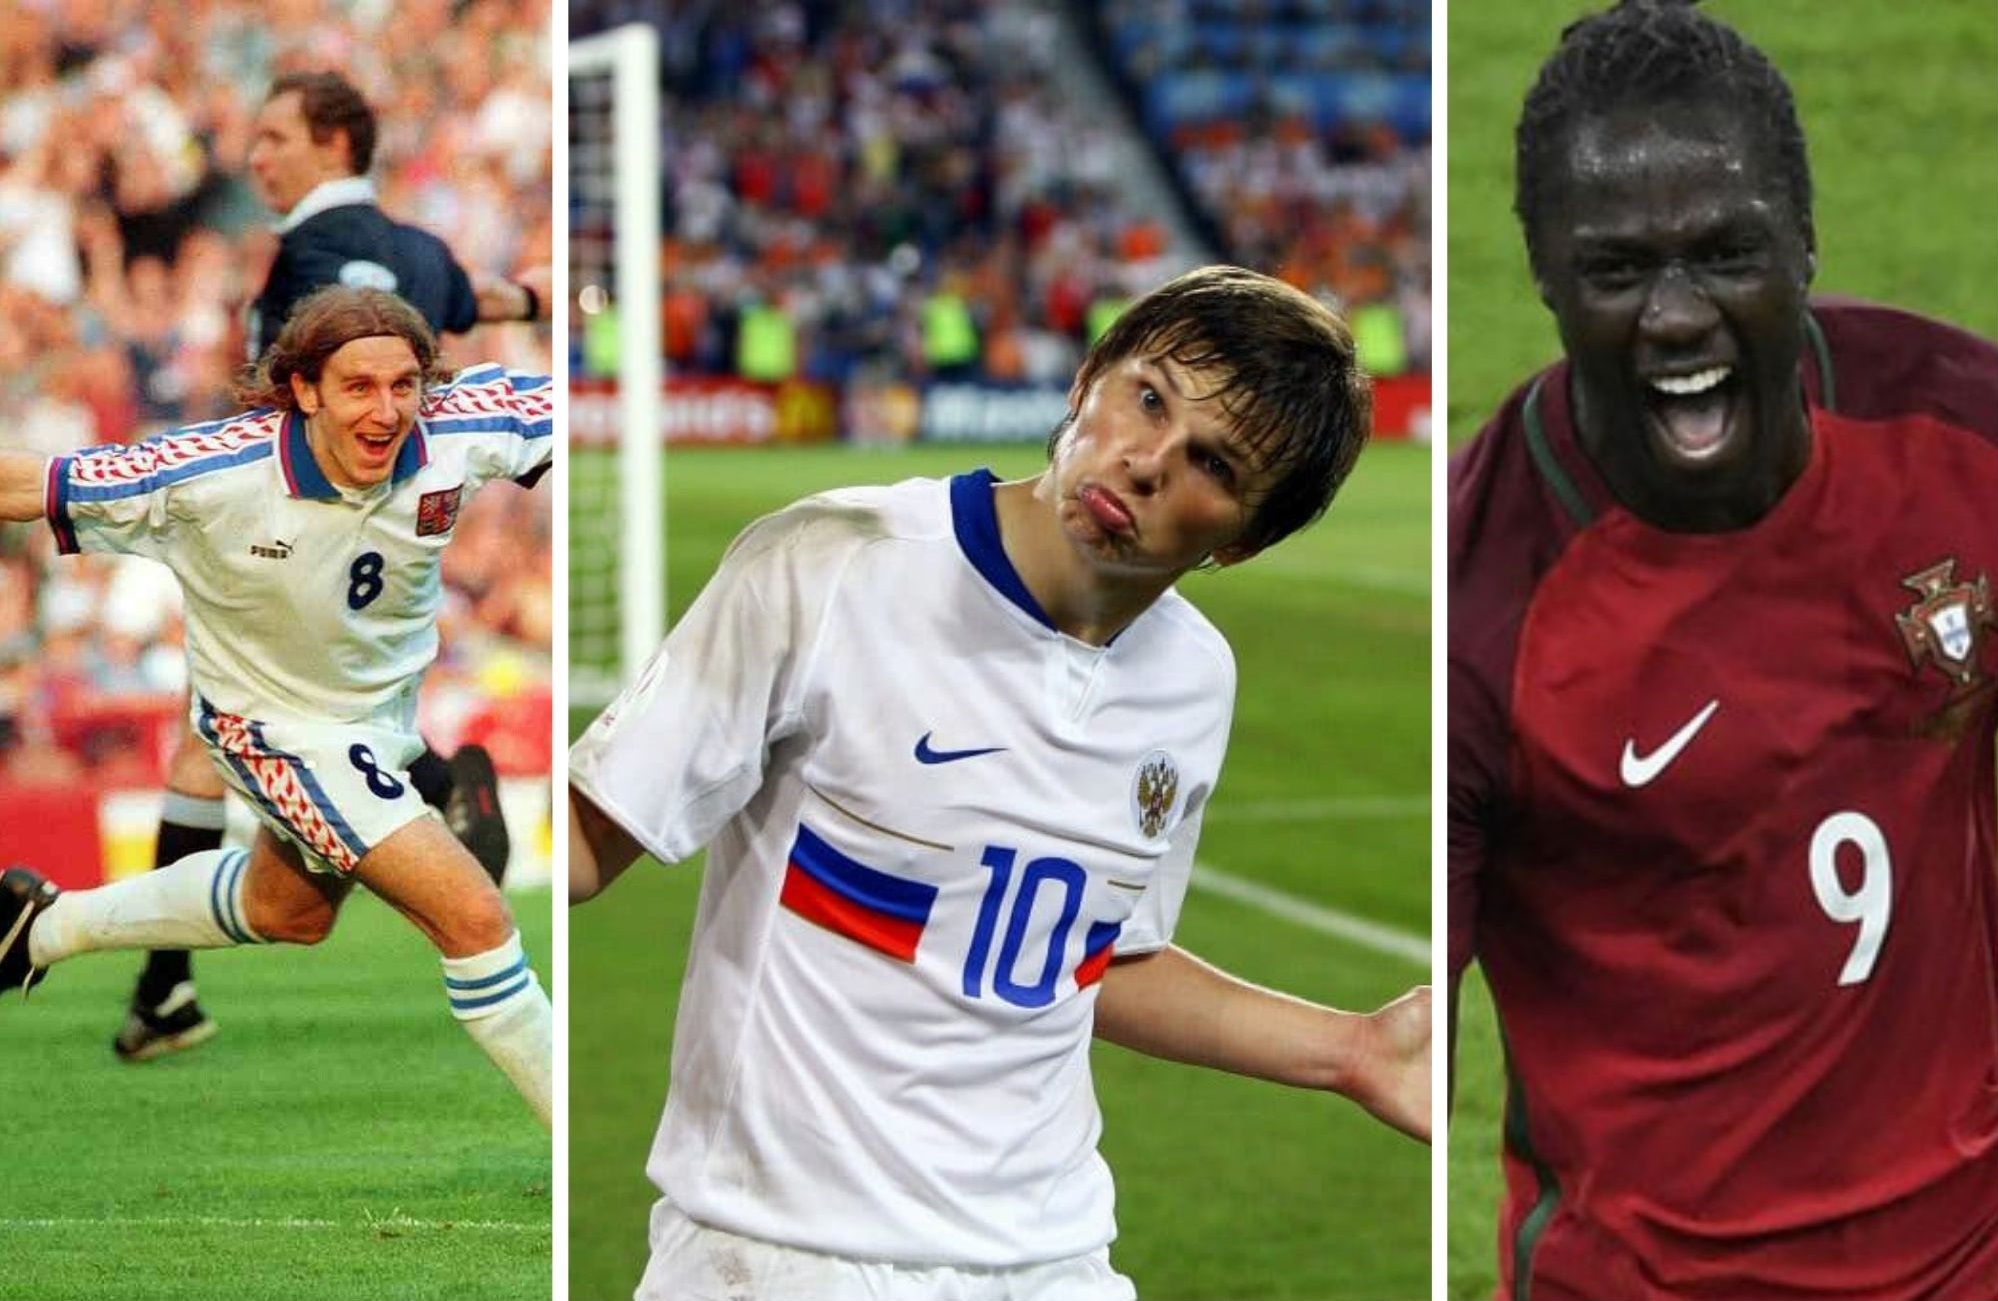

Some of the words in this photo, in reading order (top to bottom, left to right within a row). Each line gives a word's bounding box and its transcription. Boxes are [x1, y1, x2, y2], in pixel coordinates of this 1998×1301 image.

[348, 552, 383, 610] 8
[349, 743, 405, 800] 8
[963, 845, 1086, 1008] 10
[1809, 811, 1893, 986] 9
